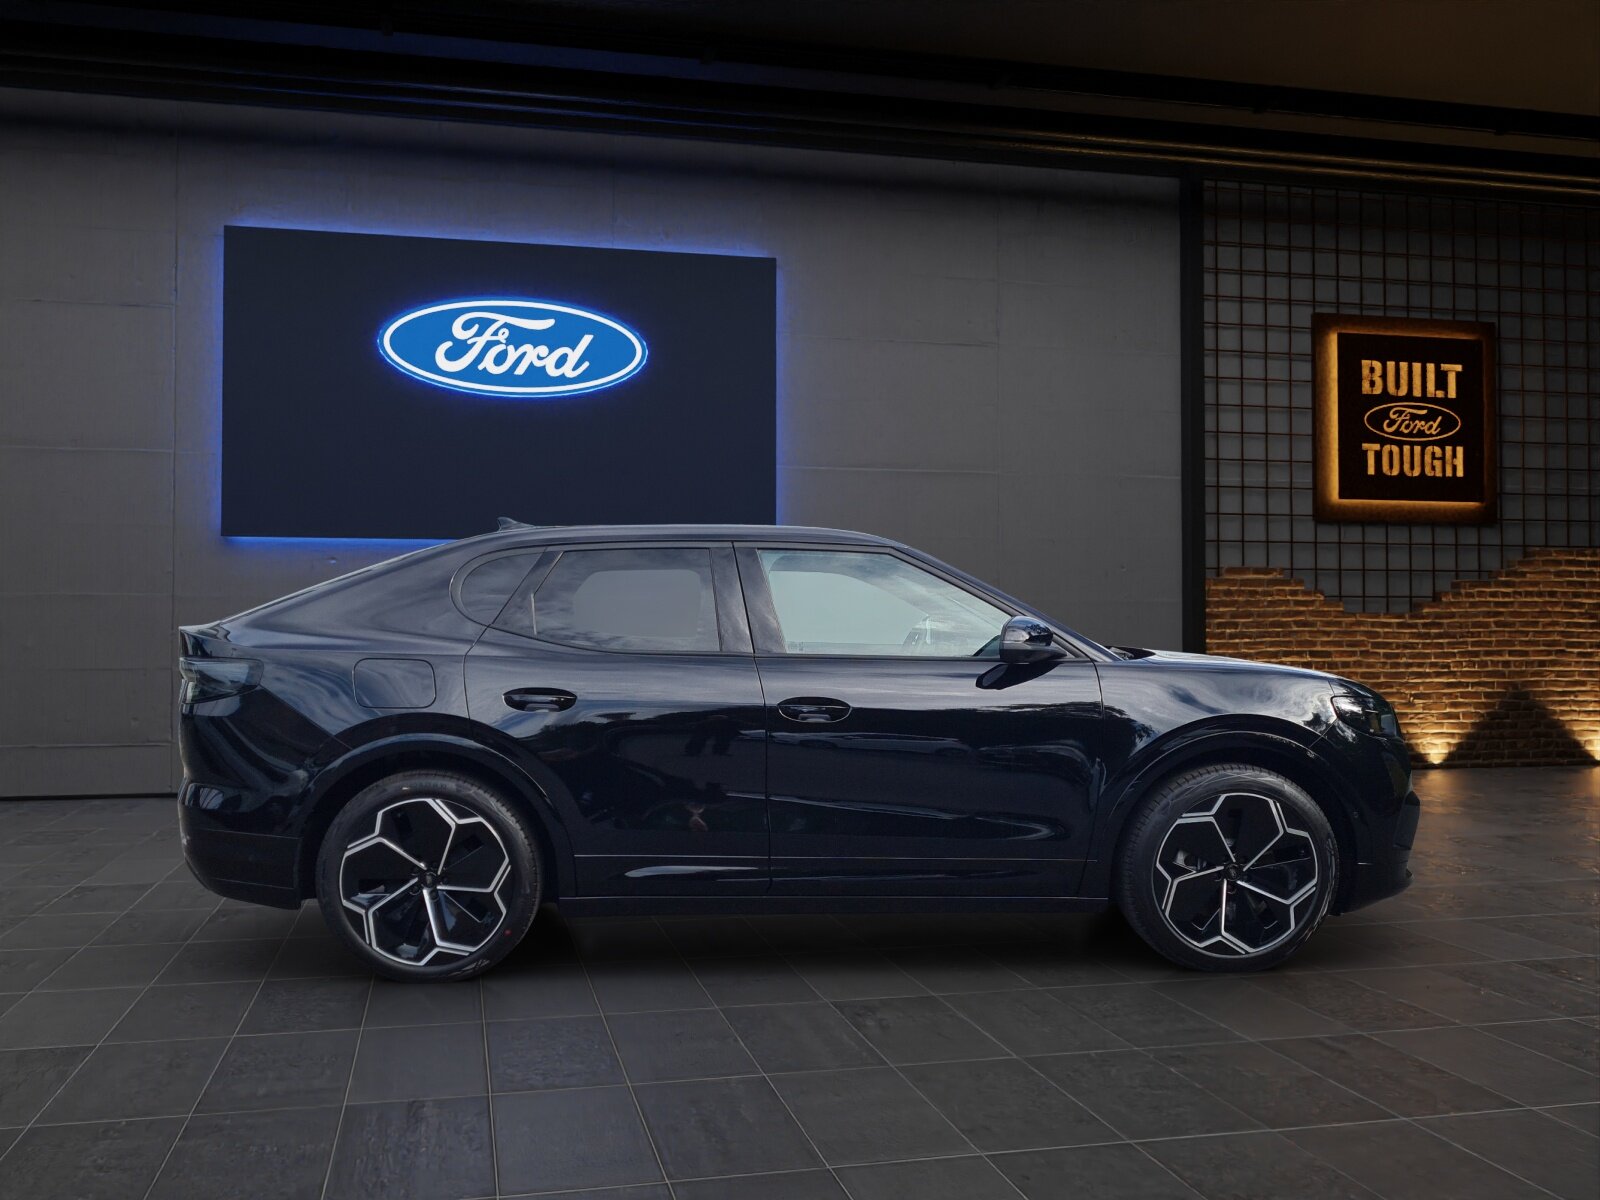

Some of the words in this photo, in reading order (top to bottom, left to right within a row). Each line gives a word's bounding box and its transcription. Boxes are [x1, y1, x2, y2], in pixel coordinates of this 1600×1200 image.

[434, 311, 594, 379] Ford
[1361, 359, 1463, 398] BUILT
[1383, 407, 1442, 435] Ford
[1361, 443, 1464, 477] TOUGH
